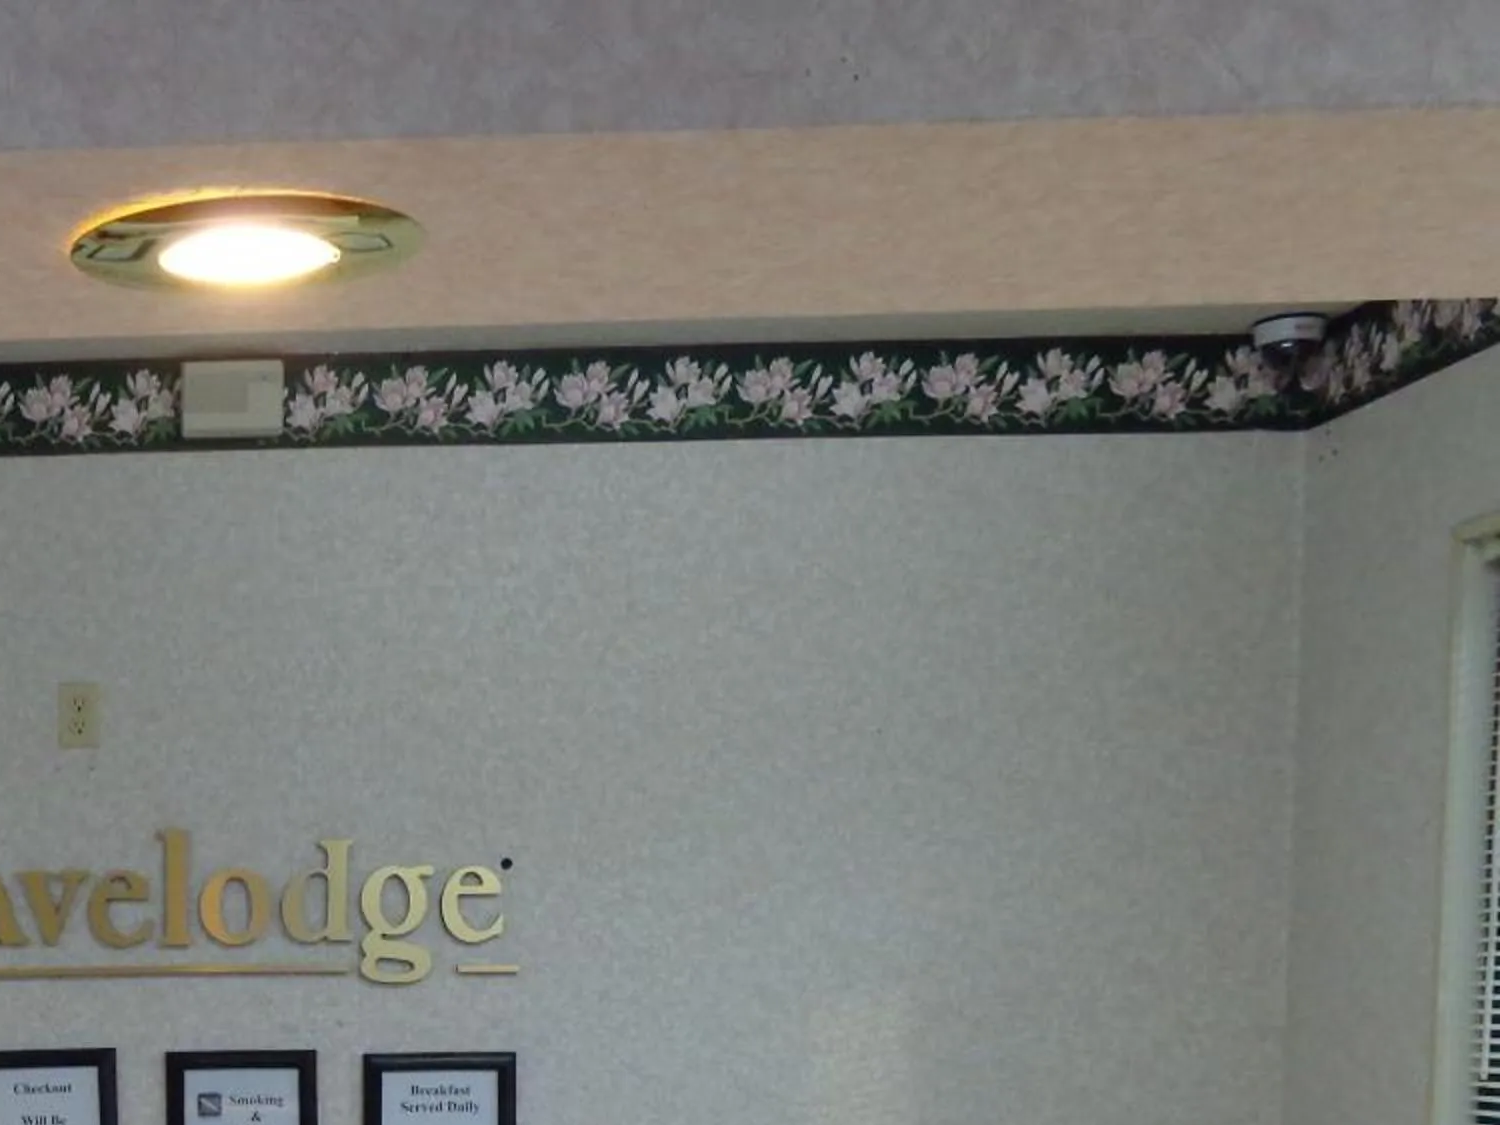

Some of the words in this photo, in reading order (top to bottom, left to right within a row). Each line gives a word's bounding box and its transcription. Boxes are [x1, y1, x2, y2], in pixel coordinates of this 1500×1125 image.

[13, 1083, 72, 1095] Checkout
[411, 1084, 471, 1096] Breakfast
[229, 1093, 284, 1108] Smoking
[401, 1100, 443, 1113] Served
[447, 1100, 480, 1115] Daily
[52, 1115, 67, 1125] Be
[251, 1111, 261, 1121] &
